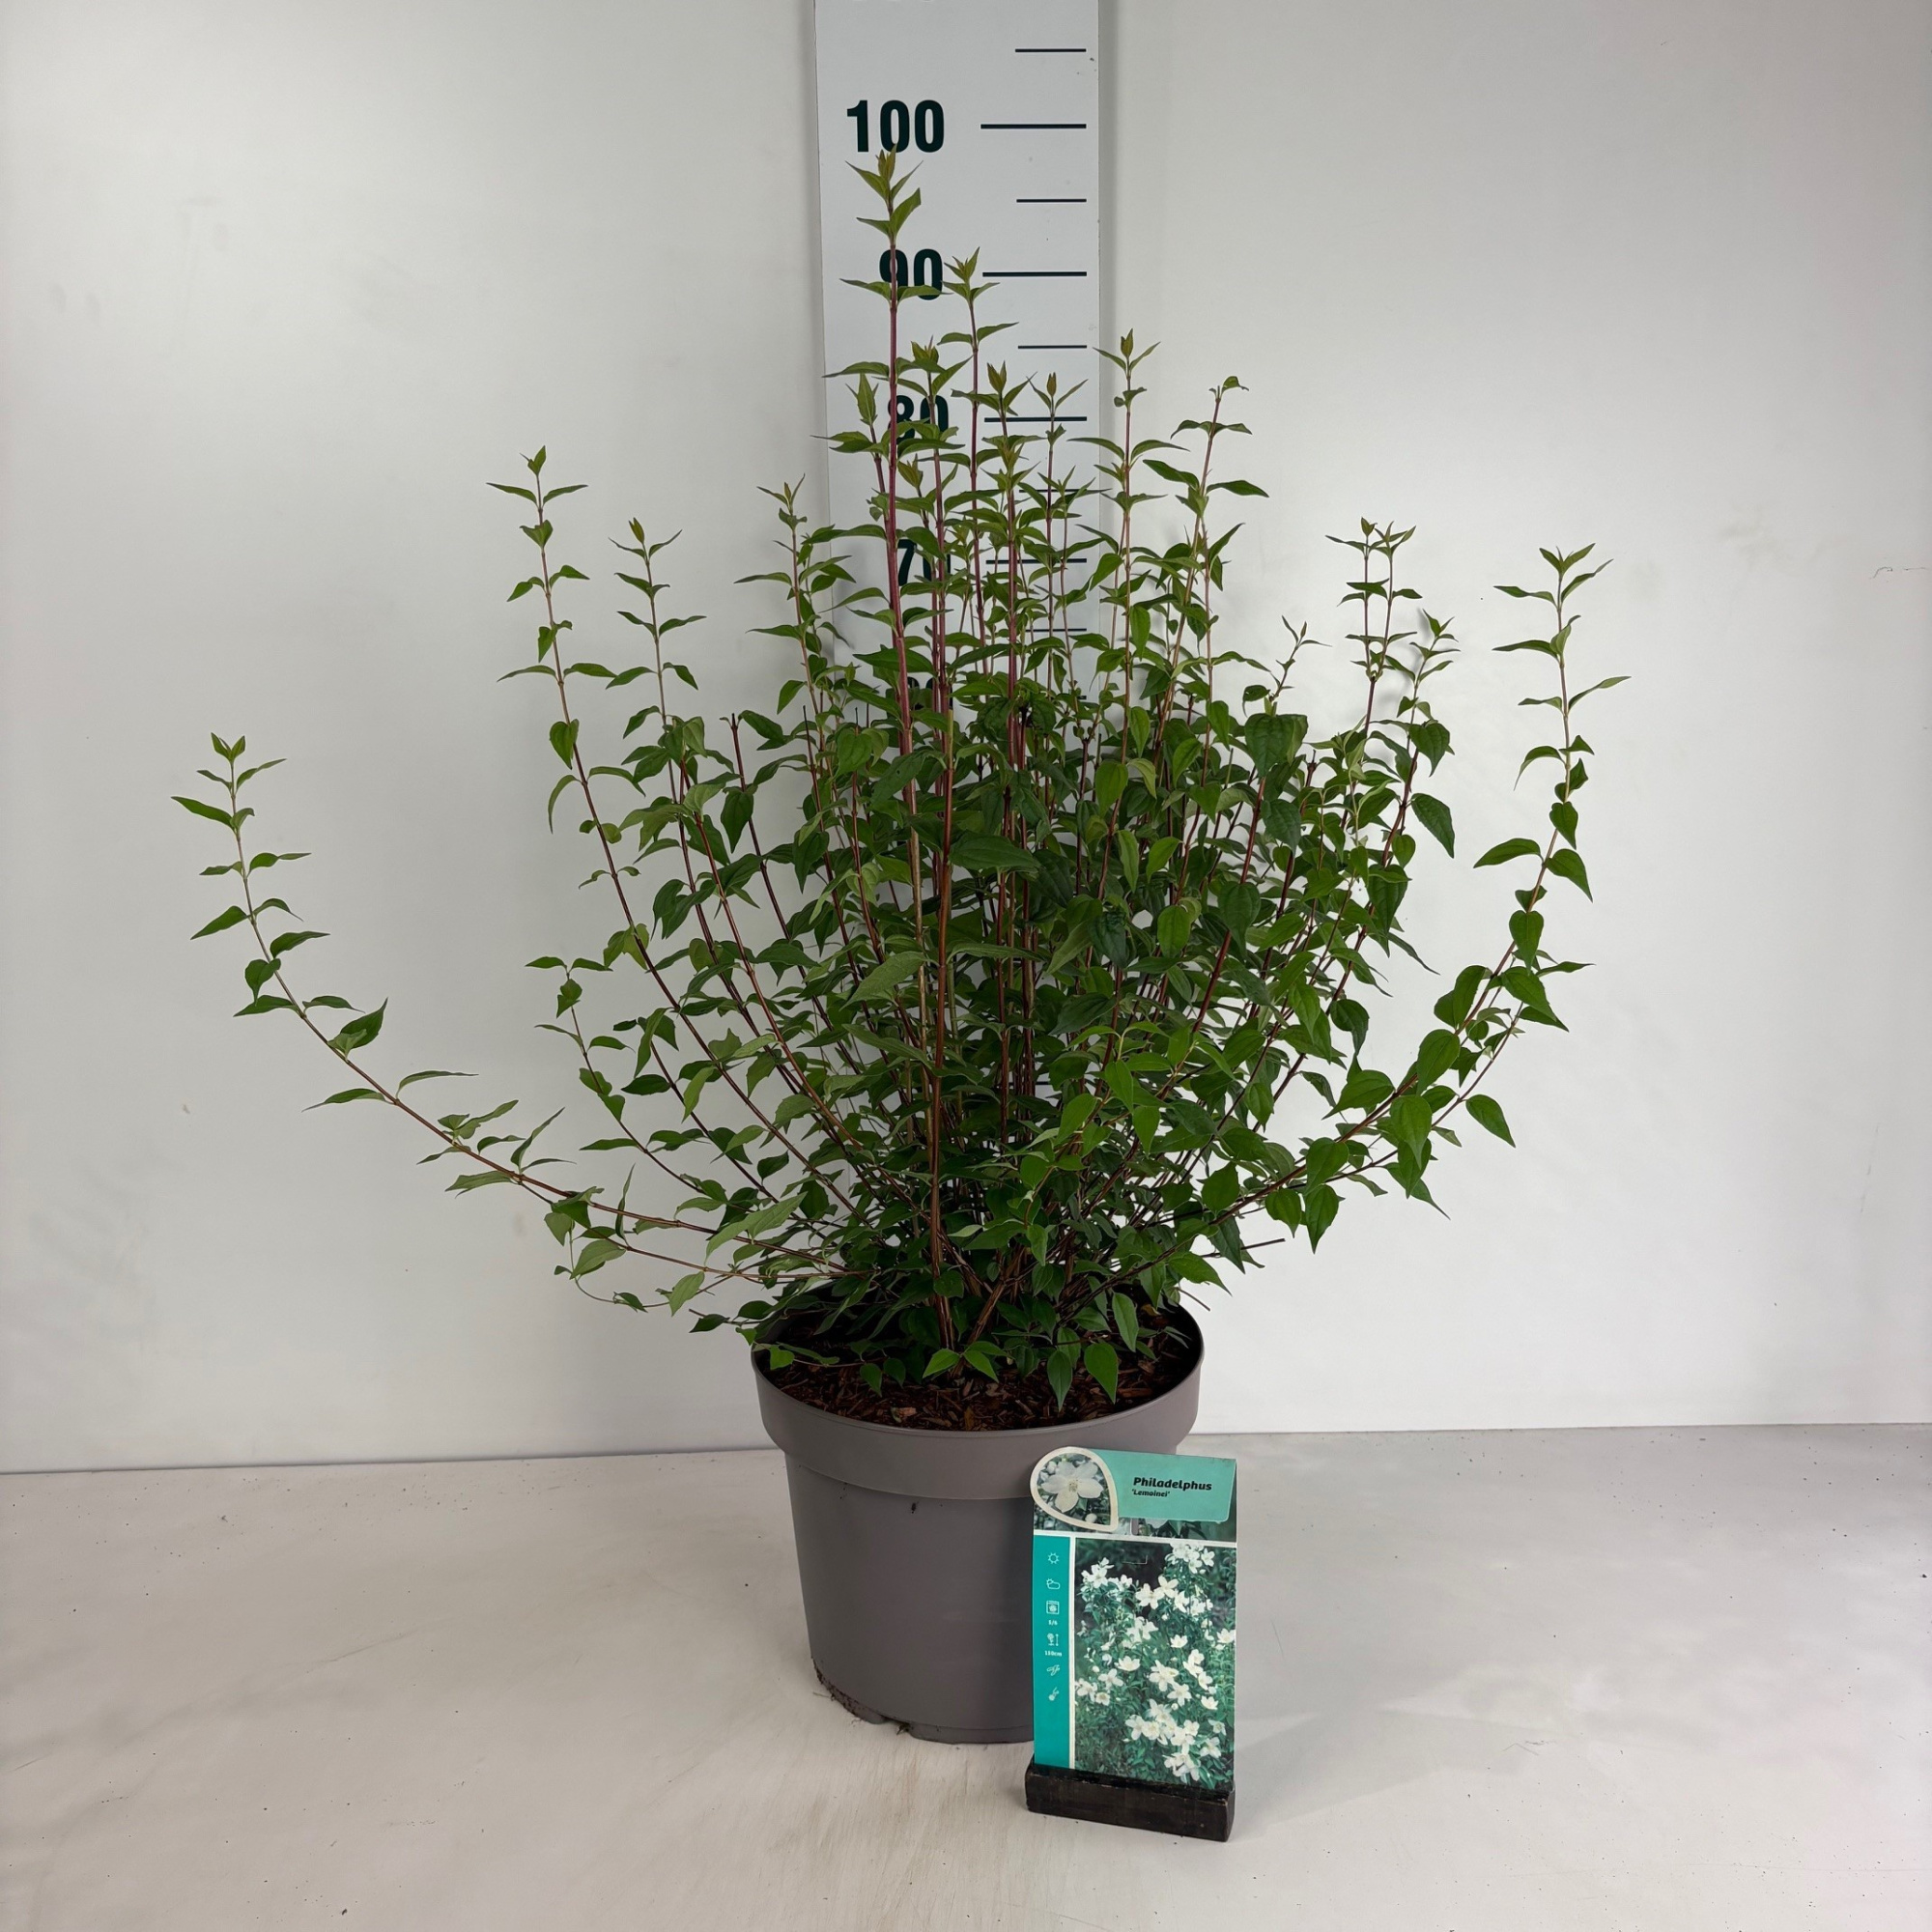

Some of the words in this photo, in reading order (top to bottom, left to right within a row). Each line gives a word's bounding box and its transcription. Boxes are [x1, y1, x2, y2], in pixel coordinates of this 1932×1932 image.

[846, 99, 945, 153] 100
[879, 248, 943, 300] 90
[1133, 1477, 1212, 1492] Philadelphus
